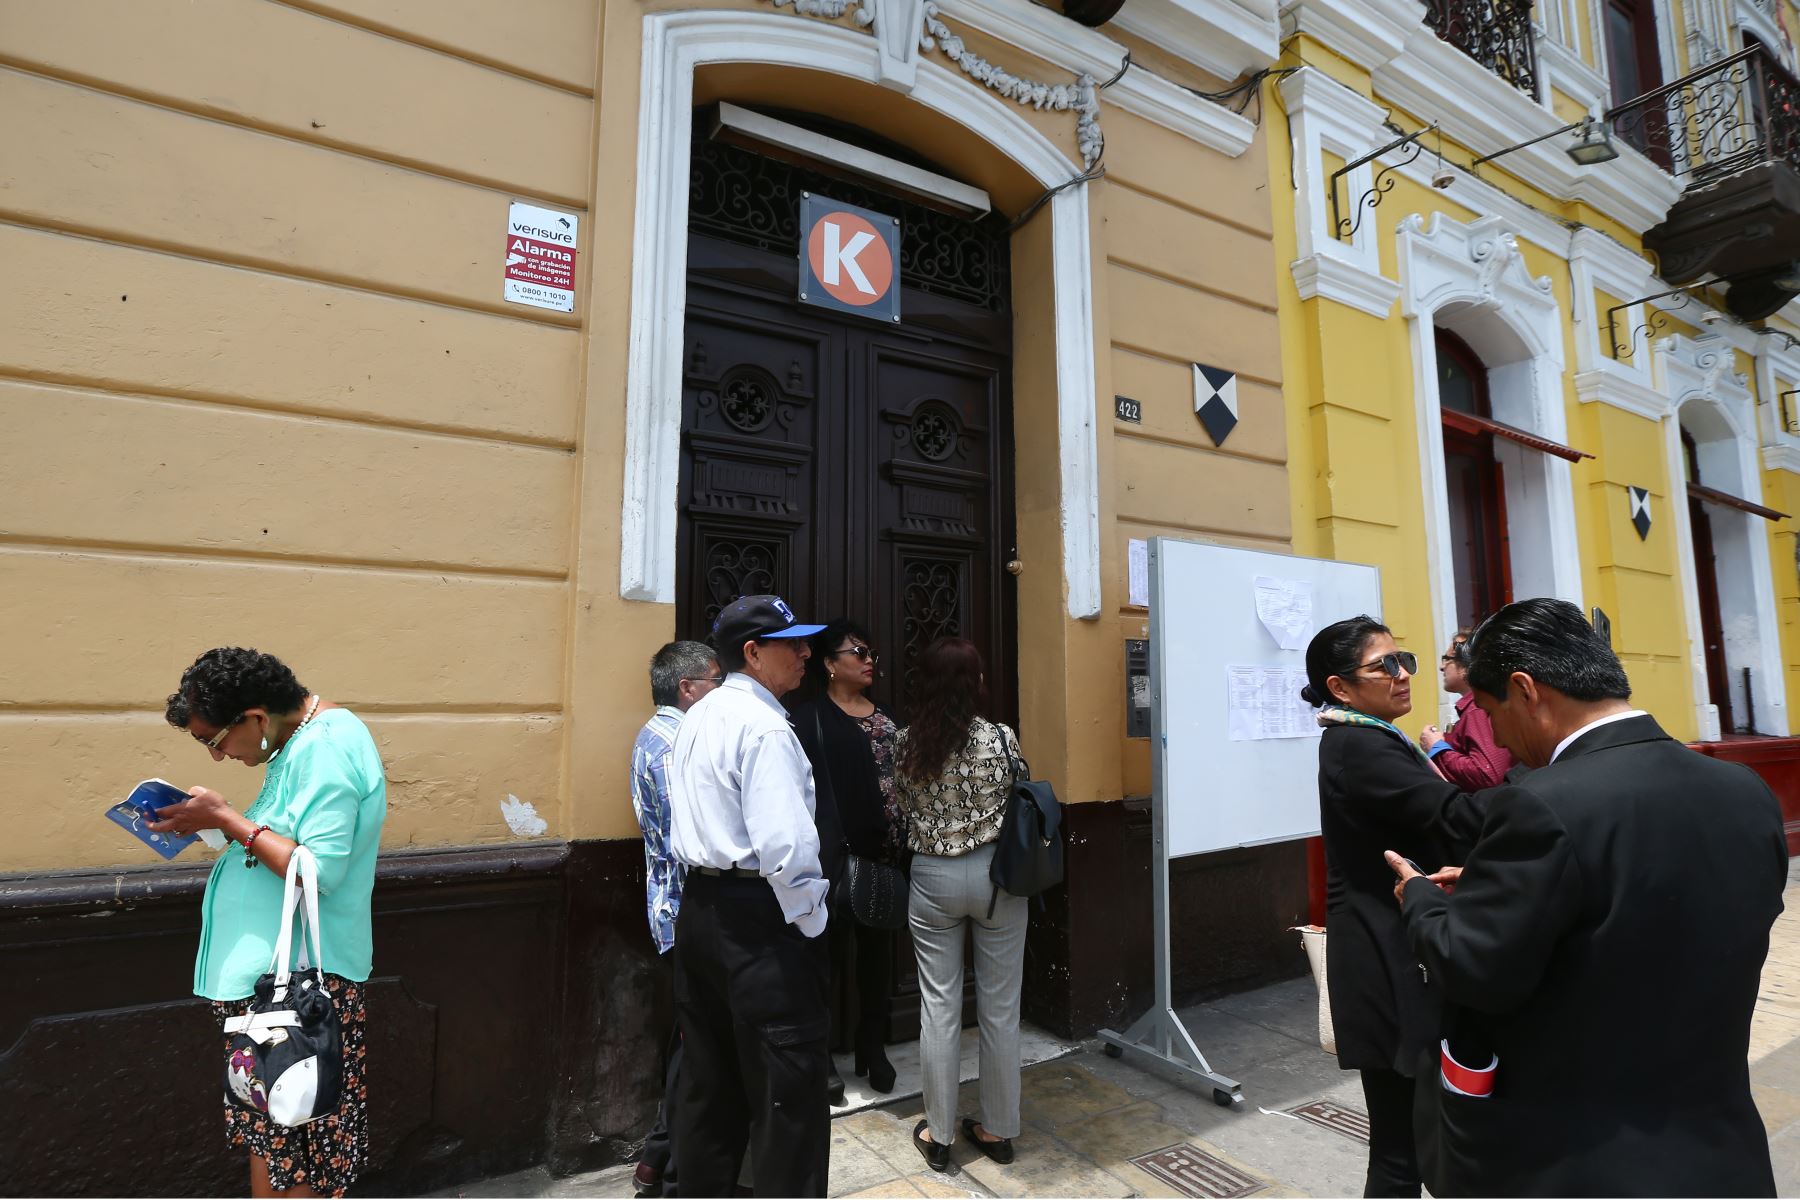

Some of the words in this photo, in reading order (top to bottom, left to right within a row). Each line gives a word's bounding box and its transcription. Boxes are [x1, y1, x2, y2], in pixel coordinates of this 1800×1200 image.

[512, 222, 572, 243] verisure
[511, 239, 572, 262] Alarma
[823, 221, 878, 296] K
[527, 262, 537, 270] de
[538, 264, 571, 277] imágenes
[540, 260, 571, 271] grabación
[510, 267, 552, 282] Monitoreo
[553, 276, 570, 286] 24H
[522, 286, 542, 296] 0800
[549, 292, 567, 301] 1010
[1119, 400, 1138, 419] 422
